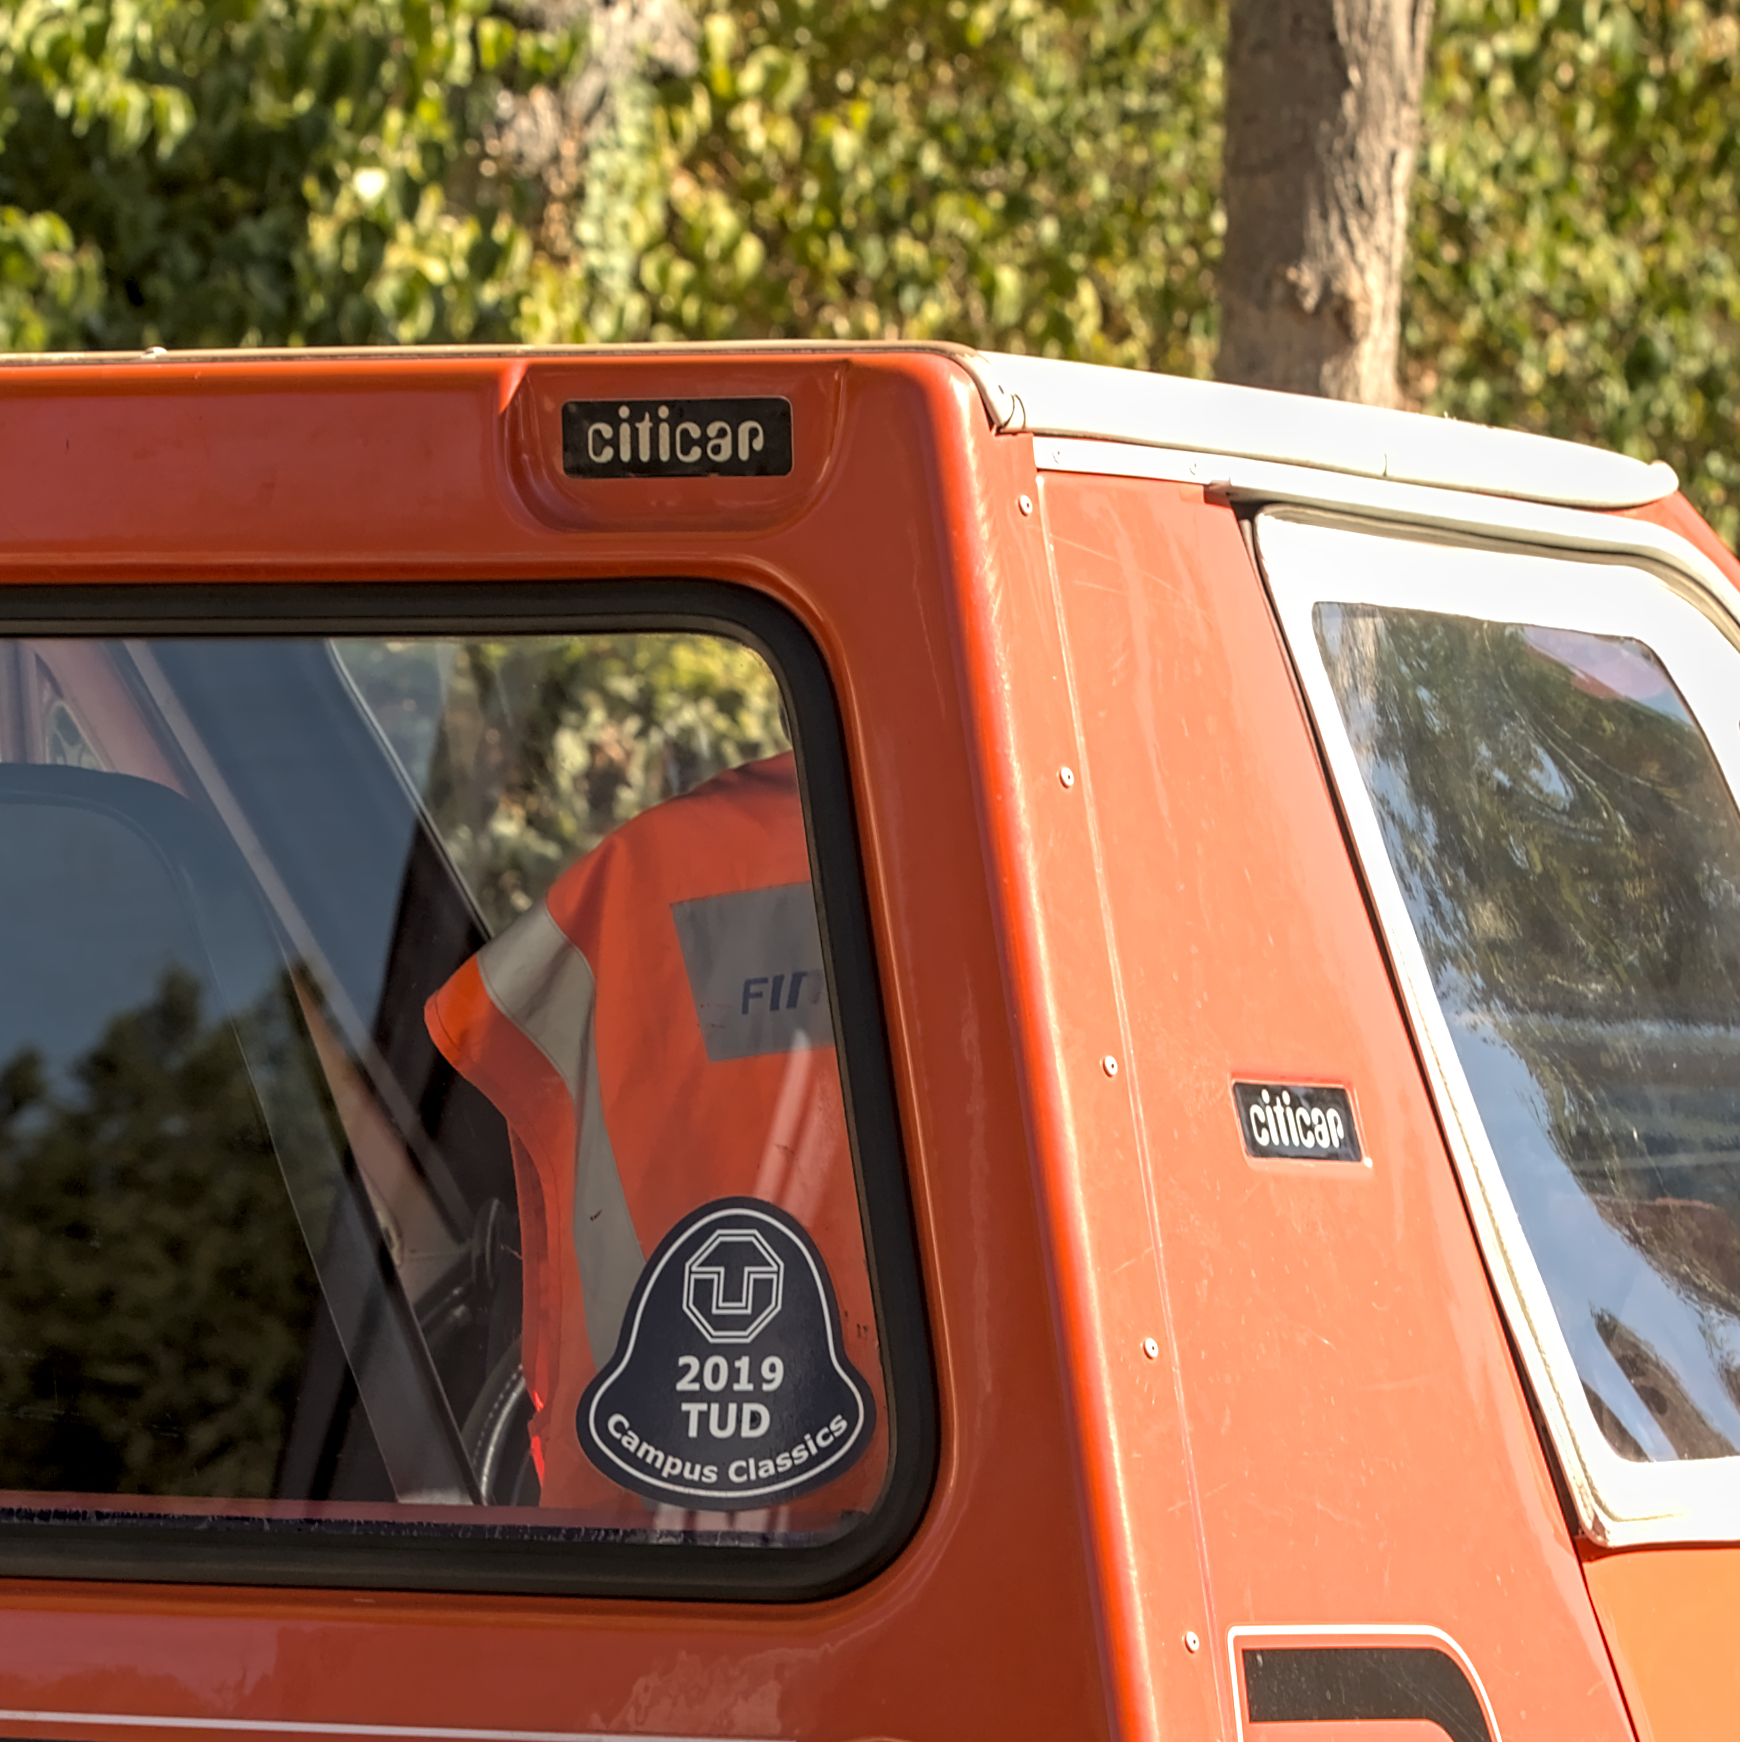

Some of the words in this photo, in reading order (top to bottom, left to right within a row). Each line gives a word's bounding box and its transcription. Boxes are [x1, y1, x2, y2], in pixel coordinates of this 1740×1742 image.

[588, 405, 764, 463] citicar
[1250, 1088, 1345, 1149] citicar
[675, 1355, 784, 1392] 2019
[607, 1413, 719, 1483] Campus
[728, 1414, 848, 1484] Classics
[681, 1402, 771, 1438] TUD
